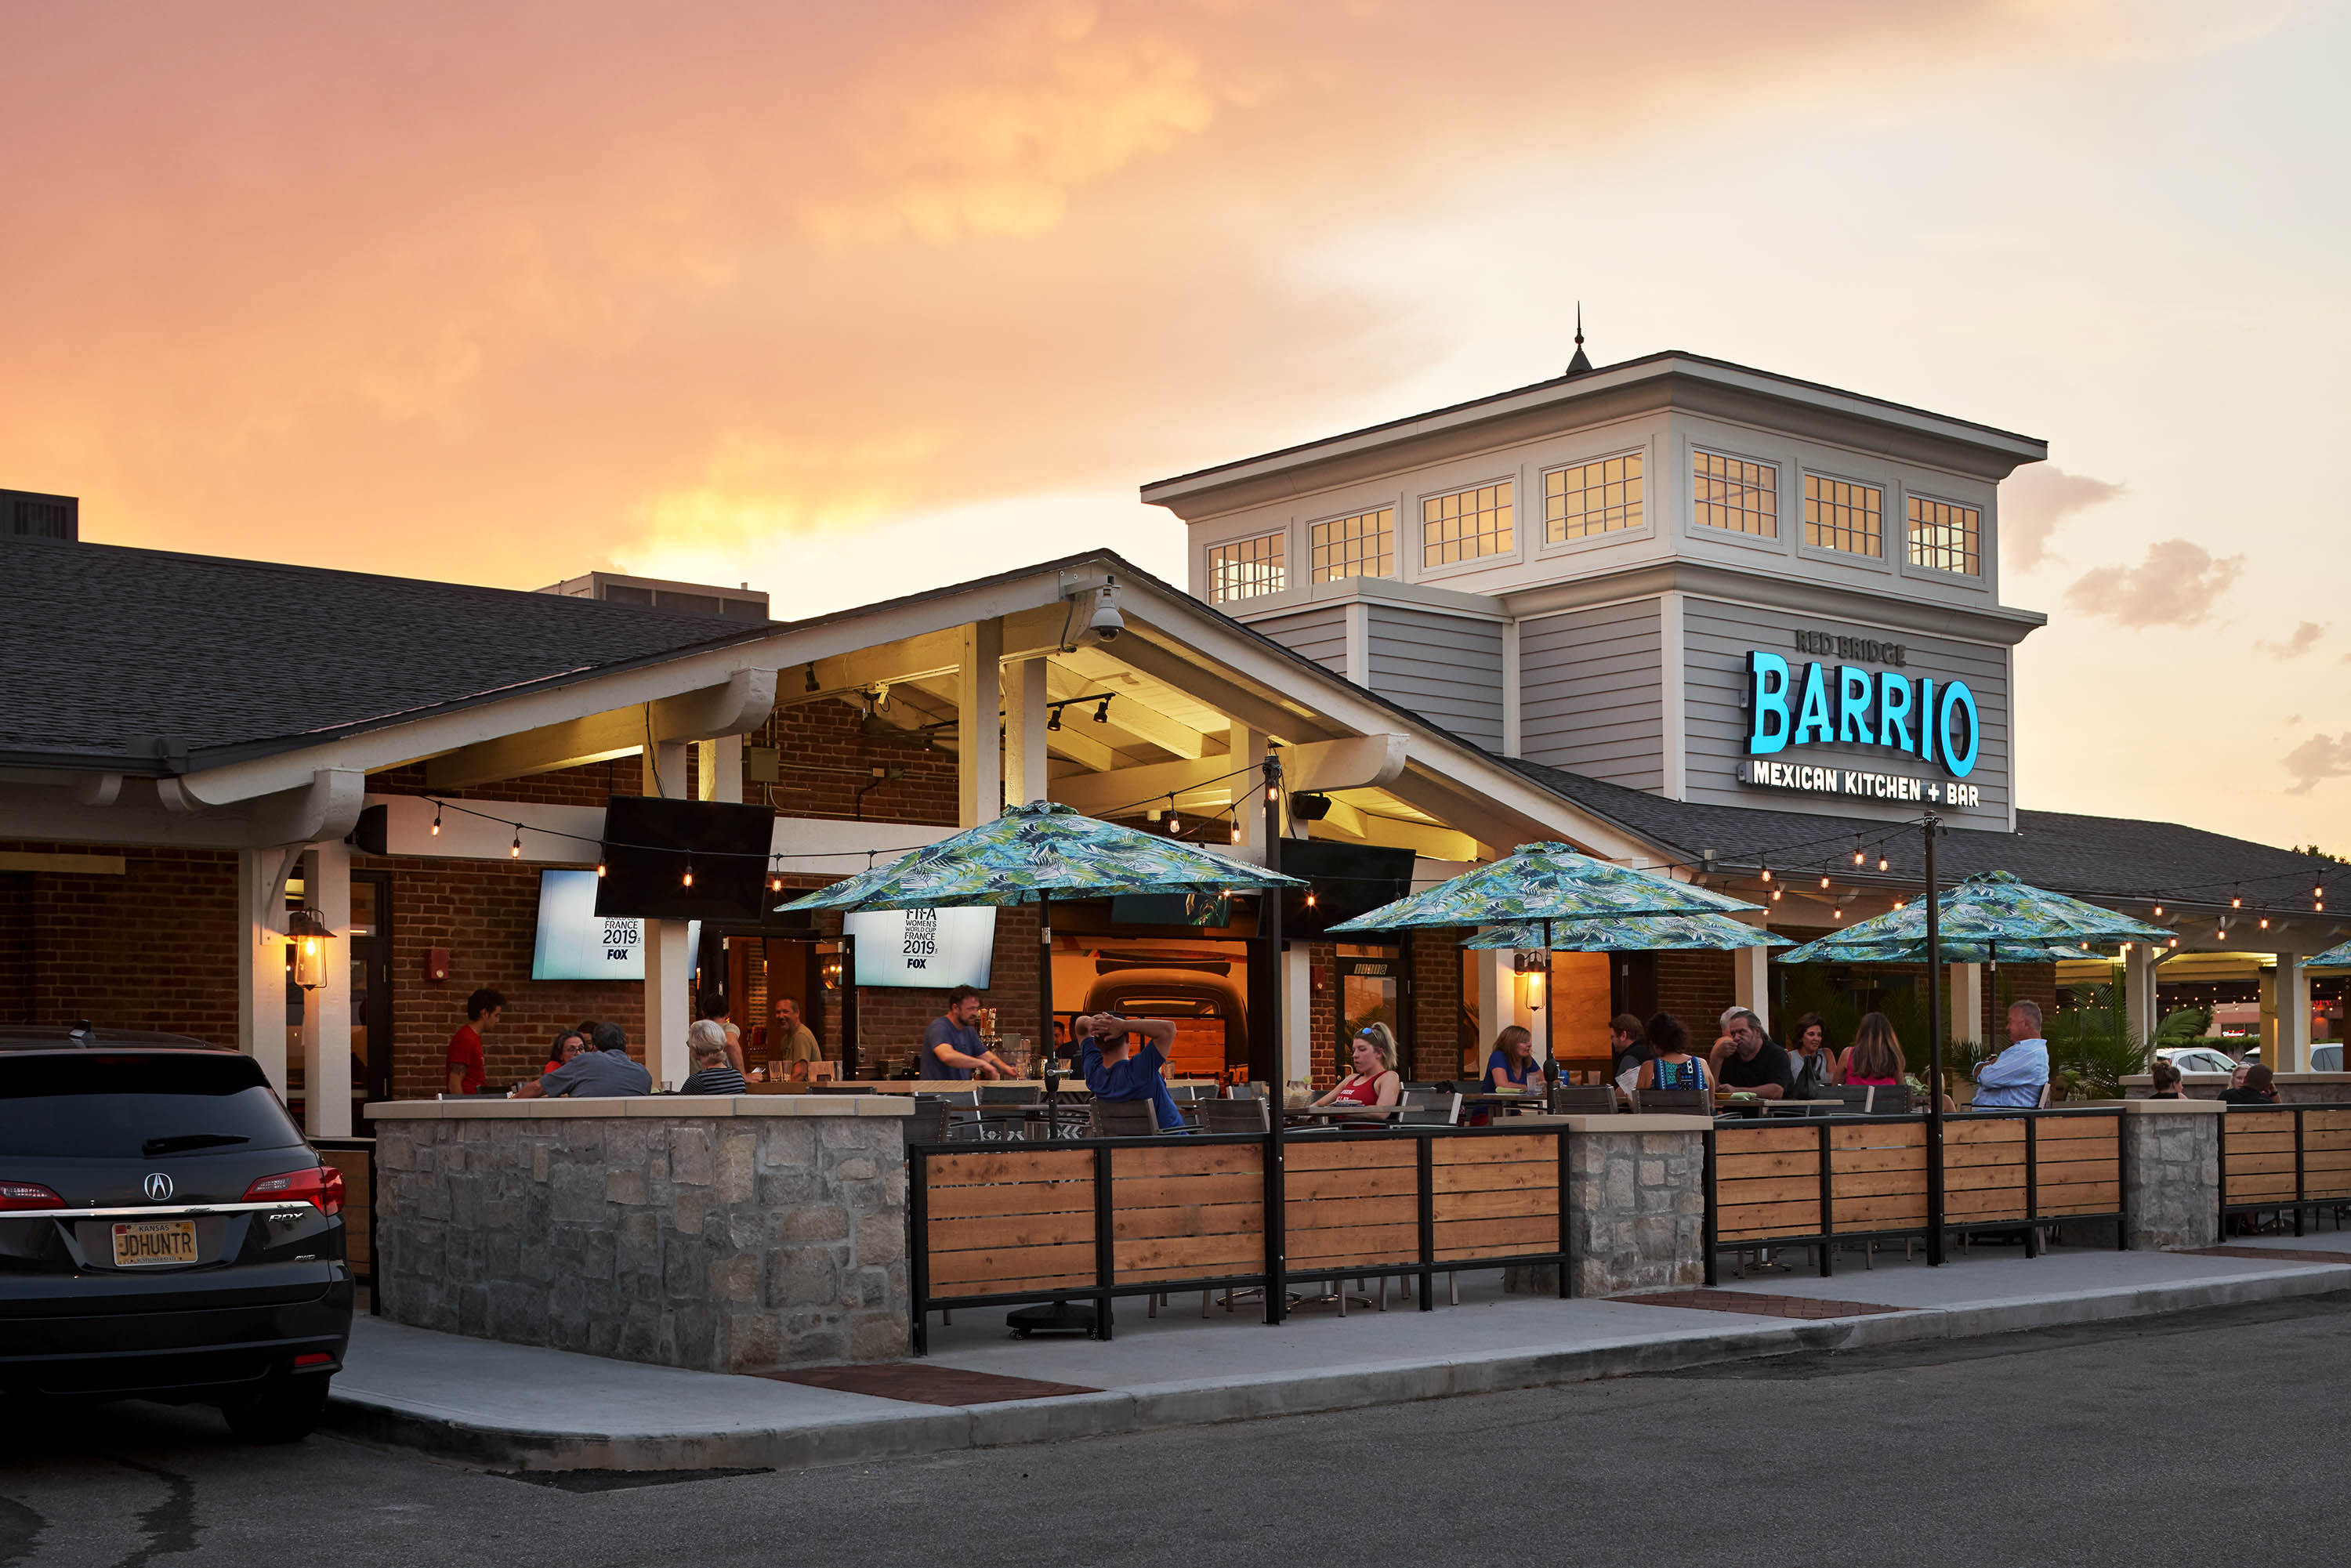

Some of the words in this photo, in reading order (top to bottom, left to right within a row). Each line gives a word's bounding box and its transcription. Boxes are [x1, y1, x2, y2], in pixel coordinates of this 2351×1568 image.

[1796, 629, 1835, 654] RED
[1838, 636, 1907, 666] BRIDGE
[1743, 650, 1980, 777] BARRIO
[1753, 760, 1838, 792] MEXICAN
[1845, 770, 1921, 801] KITCHEN
[1927, 784, 1940, 802] +
[1947, 783, 1980, 807] BAR
[906, 907, 936, 920] FIFA
[604, 920, 638, 929] FRANCE
[603, 929, 638, 944] 2019
[904, 932, 936, 940] FRANCE
[903, 940, 935, 954] 2019
[607, 949, 629, 960] FOX
[907, 958, 926, 969] FOX
[269, 1212, 303, 1222] RDX
[120, 1232, 192, 1256] JDHUNTR
